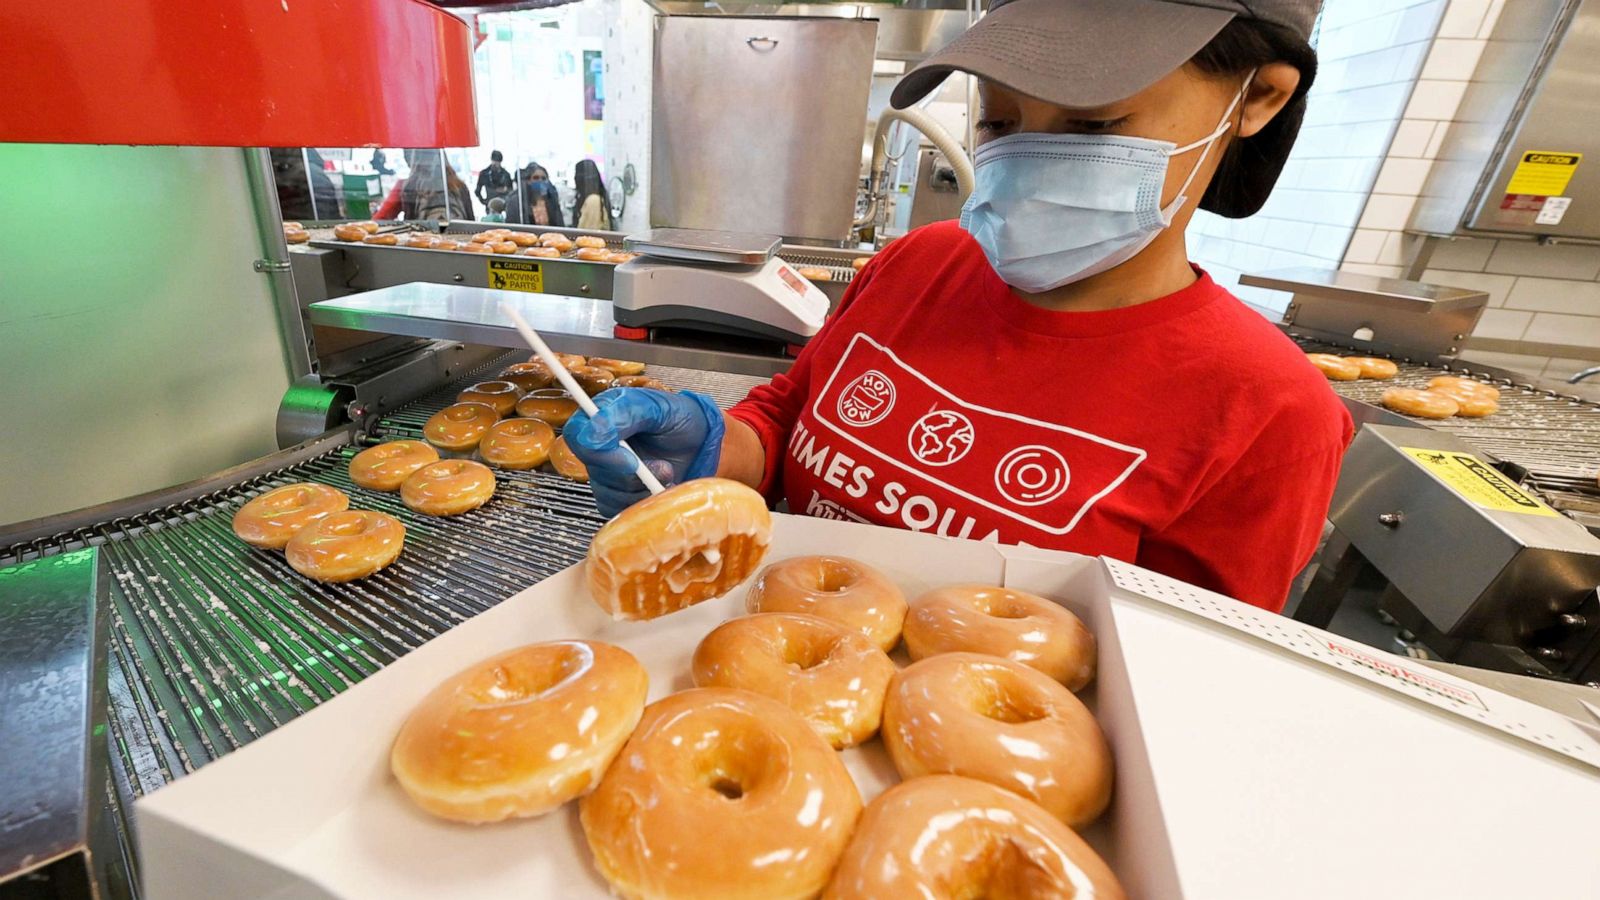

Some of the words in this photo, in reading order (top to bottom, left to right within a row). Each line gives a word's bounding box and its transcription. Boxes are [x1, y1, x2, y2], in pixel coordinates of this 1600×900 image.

[503, 262, 533, 271] CAUTION
[505, 272, 540, 283] MOVING
[509, 280, 537, 291] PARTS
[862, 375, 890, 397] HOT
[843, 398, 872, 421] NOW
[788, 419, 876, 499] TIMES
[1471, 466, 1533, 504] CAUTION
